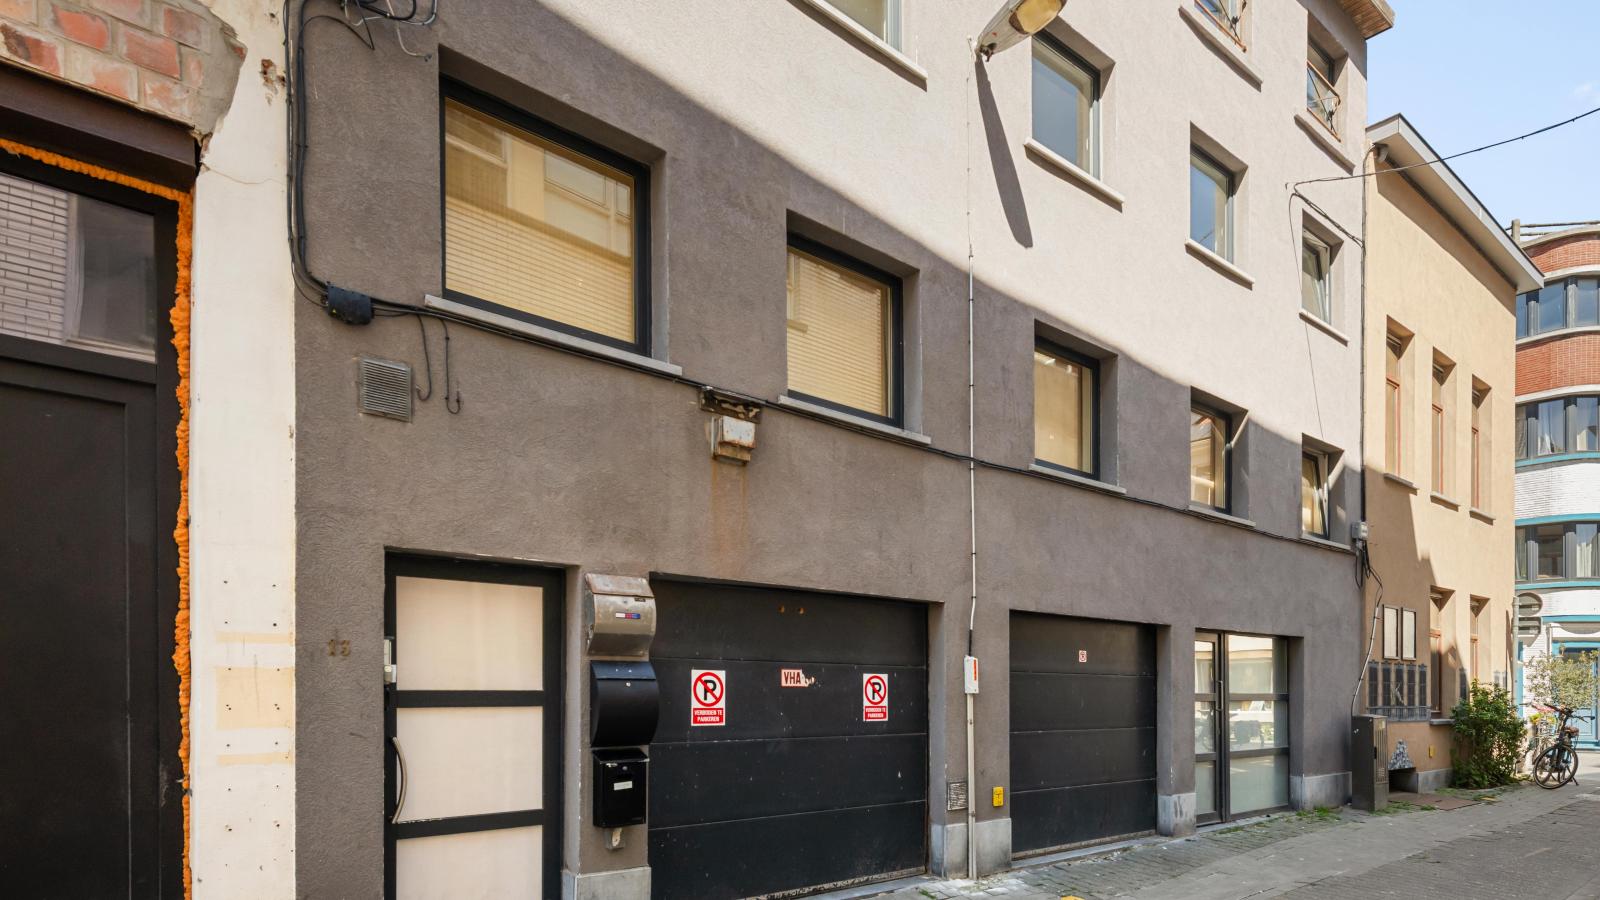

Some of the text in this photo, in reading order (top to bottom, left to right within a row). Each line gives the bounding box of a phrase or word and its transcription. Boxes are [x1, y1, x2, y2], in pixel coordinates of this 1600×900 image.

[783, 671, 802, 685] VHA
[704, 679, 716, 700] P
[872, 682, 882, 700] P
